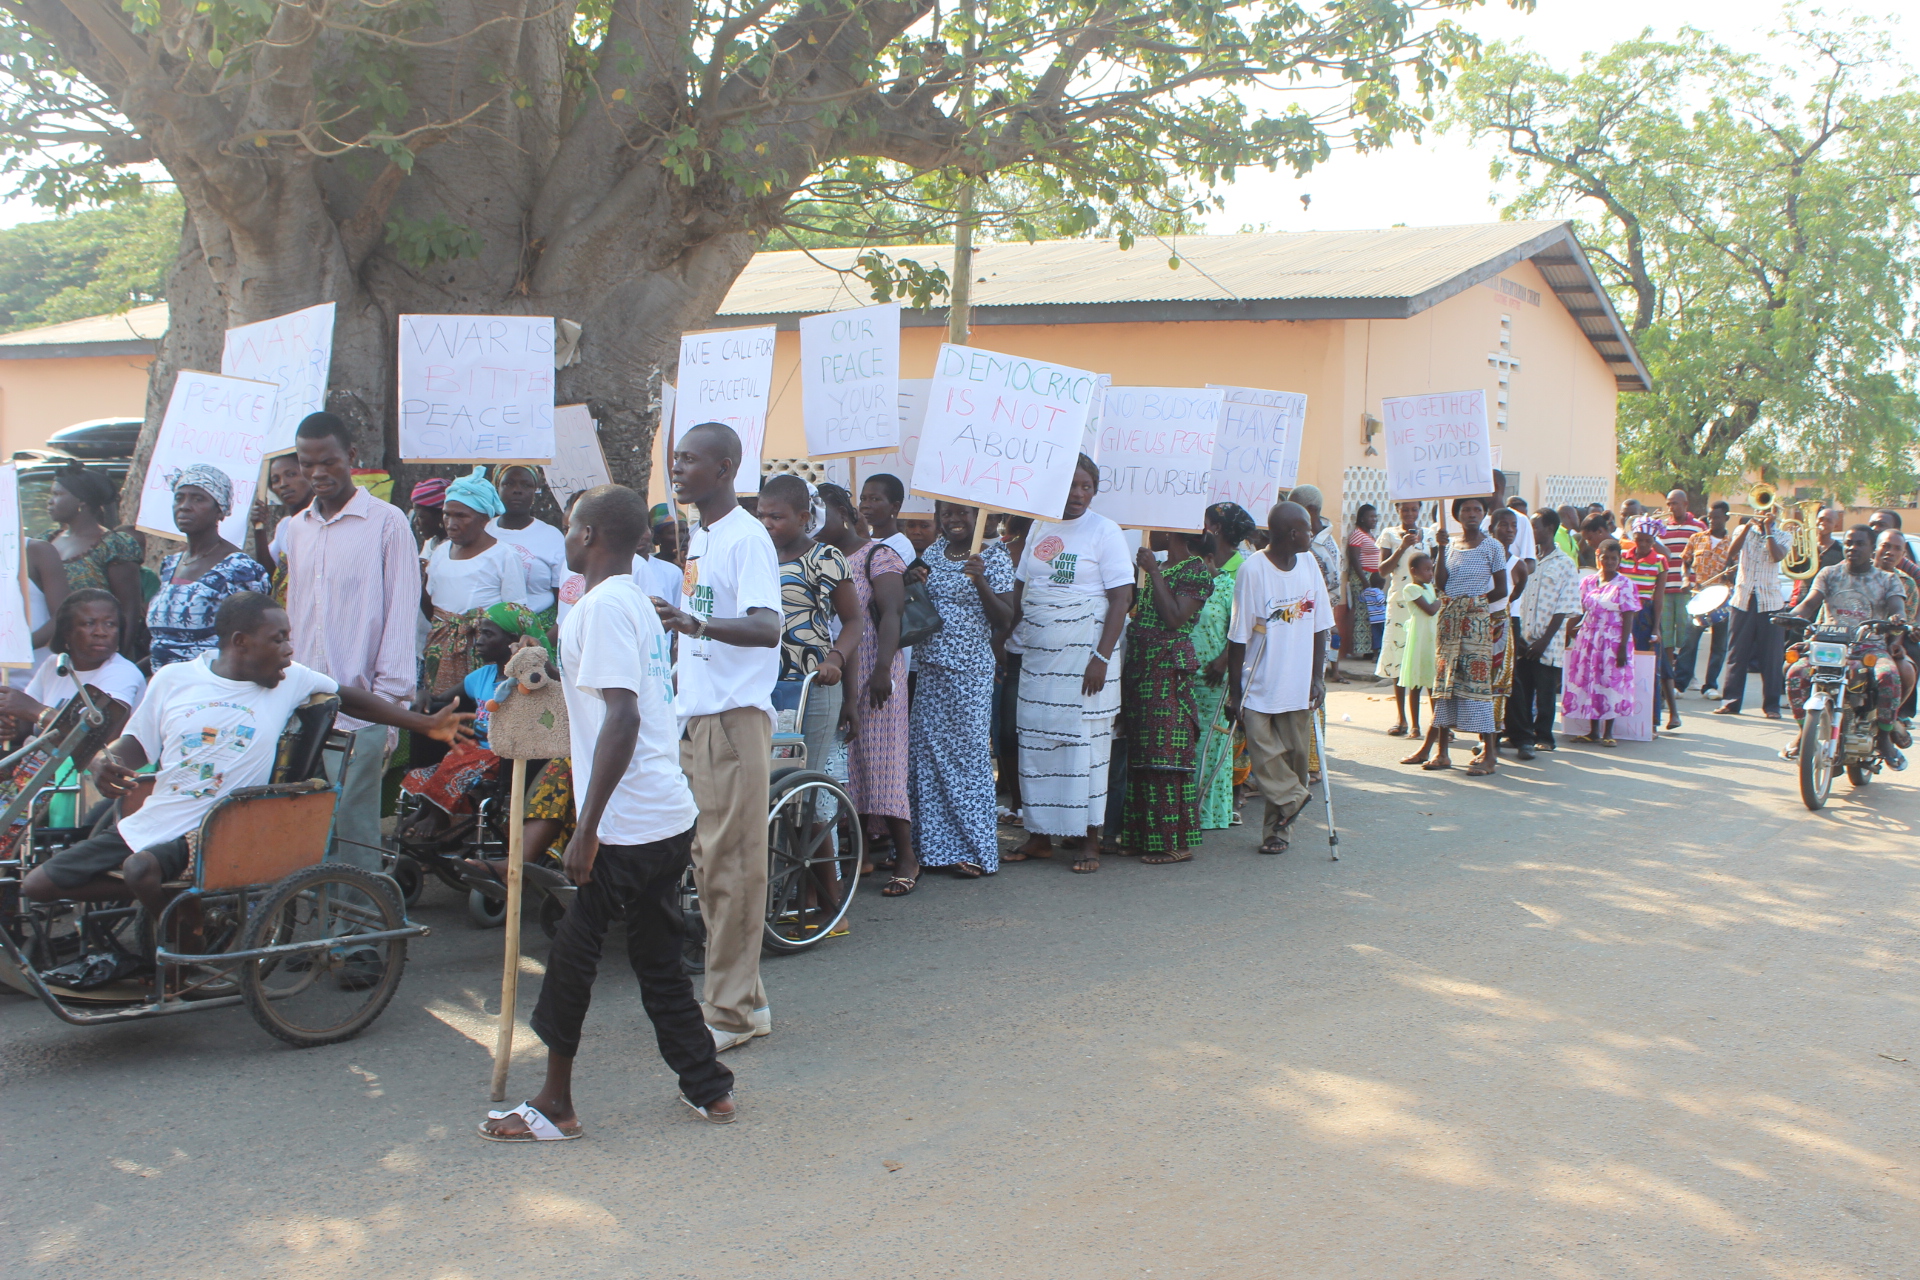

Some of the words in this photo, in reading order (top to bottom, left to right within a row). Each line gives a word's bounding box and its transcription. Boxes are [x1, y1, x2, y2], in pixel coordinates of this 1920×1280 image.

[226, 315, 311, 372] WAR
[408, 319, 509, 358] WAR
[525, 325, 553, 353] IS
[831, 319, 874, 343] OUR
[685, 341, 712, 367] WE
[722, 338, 752, 361] CALL
[755, 338, 773, 357] FOR
[821, 348, 884, 384] PEACE
[424, 364, 555, 399] BITTER
[699, 376, 761, 404] PEACEFUL
[943, 348, 1097, 404] DEMOCRACY
[183, 382, 265, 423] PEACE
[401, 399, 521, 431] PEACE
[531, 404, 553, 429] IS
[828, 384, 887, 416] YOUR
[946, 387, 975, 416] IS
[991, 395, 1068, 432] NOT
[1103, 394, 1136, 418] NO
[1383, 392, 1482, 421] TOGETHER
[825, 414, 891, 447] PEACE
[1225, 406, 1289, 444] HAVE
[1393, 428, 1415, 446] WE
[1424, 421, 1480, 443] STAND
[170, 423, 264, 465] PROMOTES
[419, 431, 529, 456] SWEET
[951, 424, 1064, 469] ABOUT
[1101, 427, 1142, 452] GIVE
[1145, 431, 1166, 454] US
[1170, 430, 1216, 455] PEACE
[1414, 441, 1480, 462] DIVIDED
[939, 451, 1035, 501] WAR
[1097, 465, 1142, 494] BUT
[1396, 468, 1426, 490] WE
[1435, 464, 1491, 487] FALL
[1208, 480, 1272, 515] HANA
[1055, 561, 1075, 571] VOTE
[1059, 552, 1077, 562] OUR
[1057, 569, 1075, 580] OUR
[696, 584, 714, 599] OUR
